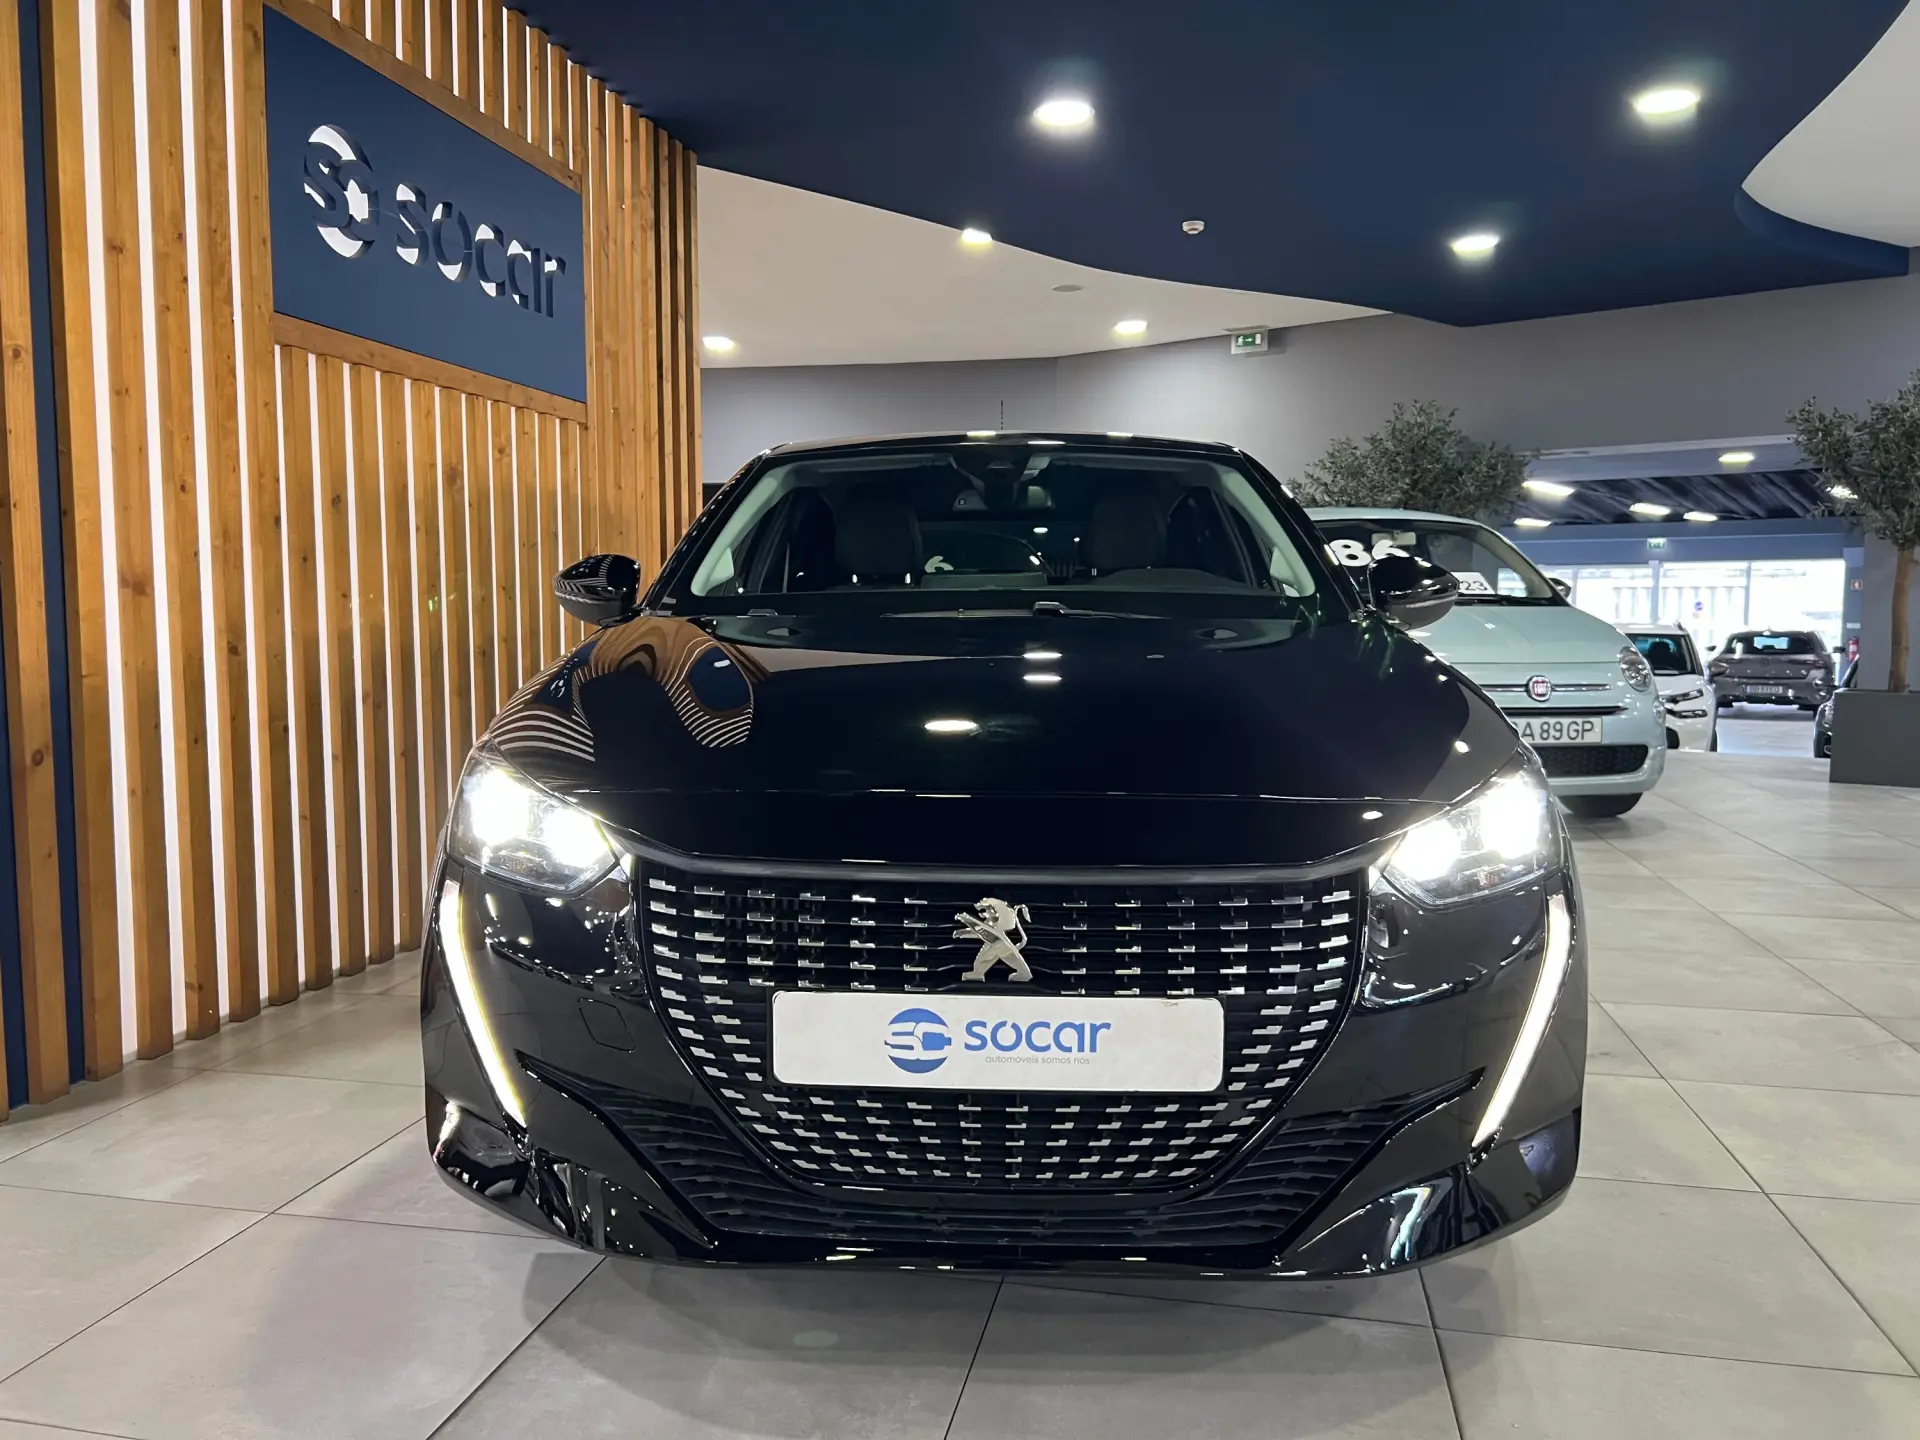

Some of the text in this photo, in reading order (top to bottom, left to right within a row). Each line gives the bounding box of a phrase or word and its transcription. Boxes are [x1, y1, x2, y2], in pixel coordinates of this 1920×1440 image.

[396, 181, 566, 318] socar
[1539, 721, 1563, 741] 89
[1567, 721, 1594, 741] GP
[964, 1020, 1112, 1053] socar
